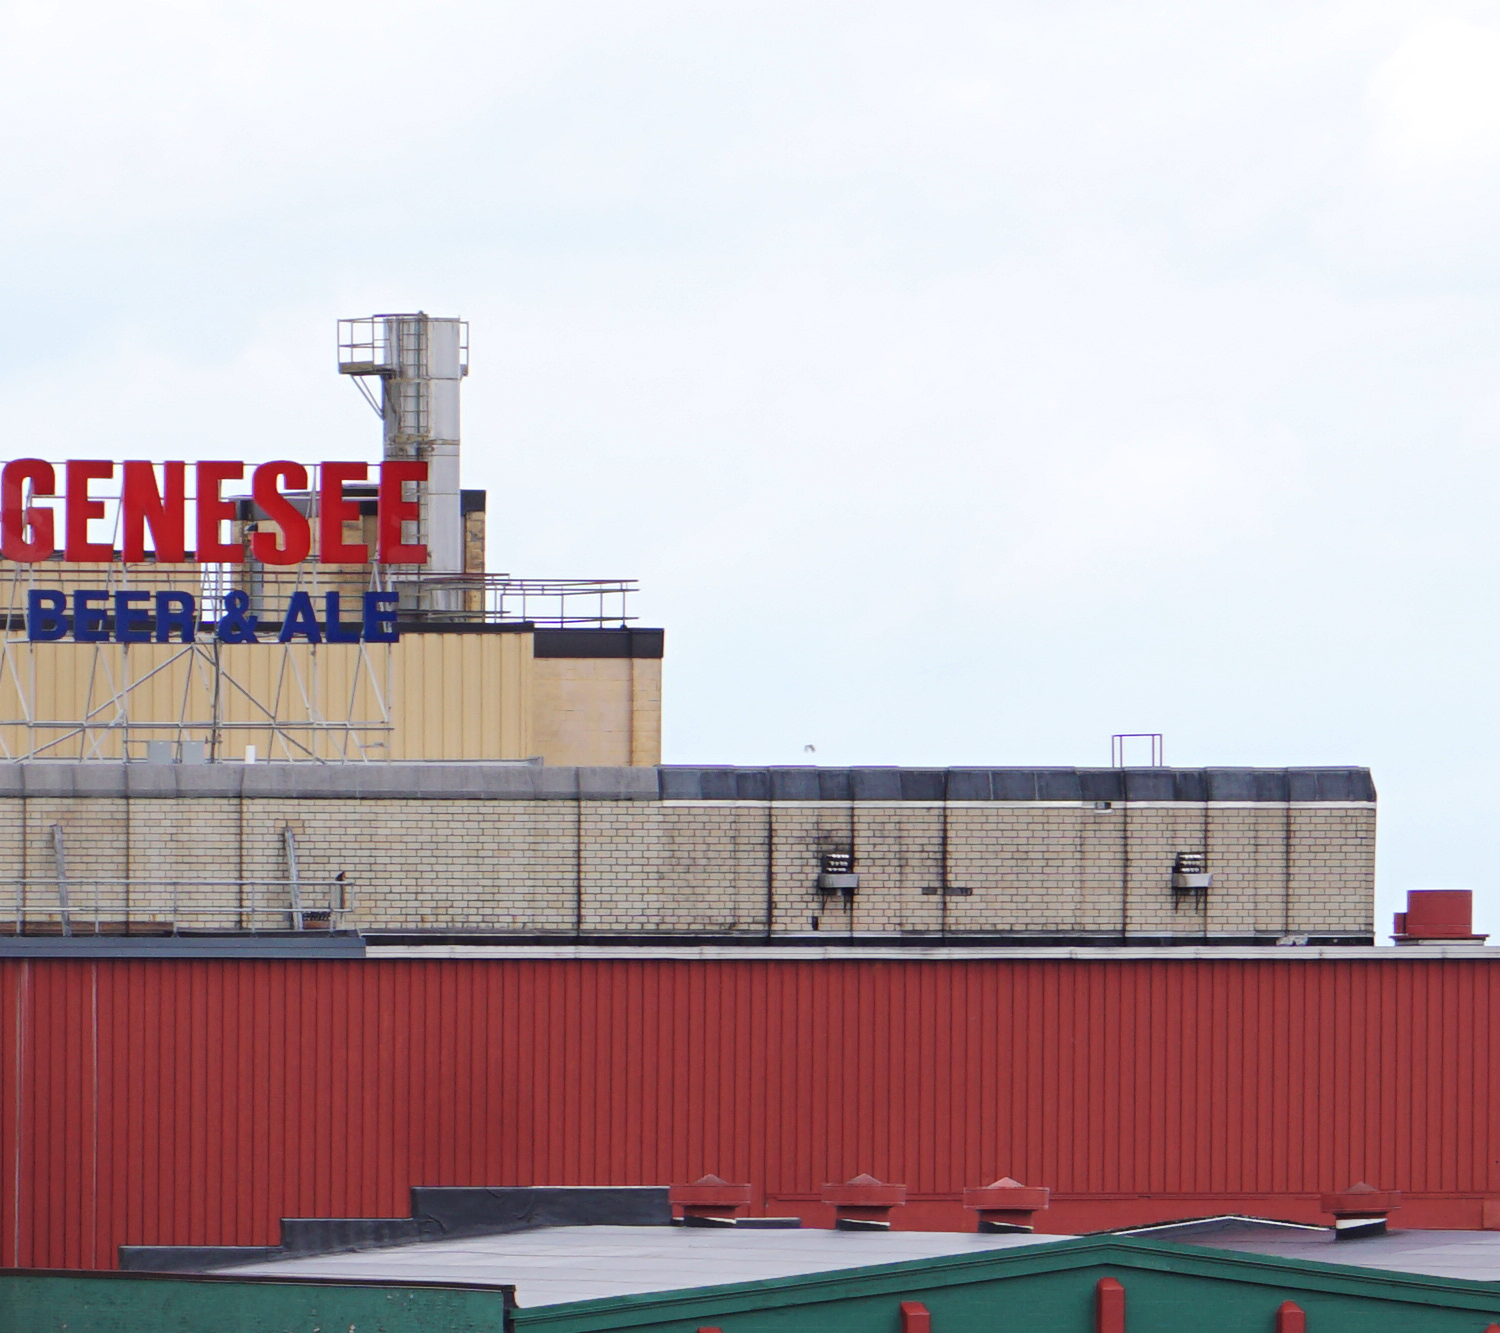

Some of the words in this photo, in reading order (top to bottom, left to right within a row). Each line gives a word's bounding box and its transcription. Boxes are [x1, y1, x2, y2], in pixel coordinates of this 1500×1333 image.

[1, 458, 428, 564] GENESEE
[28, 590, 195, 643] BEER
[218, 590, 258, 643] &
[278, 591, 400, 643] ALE
